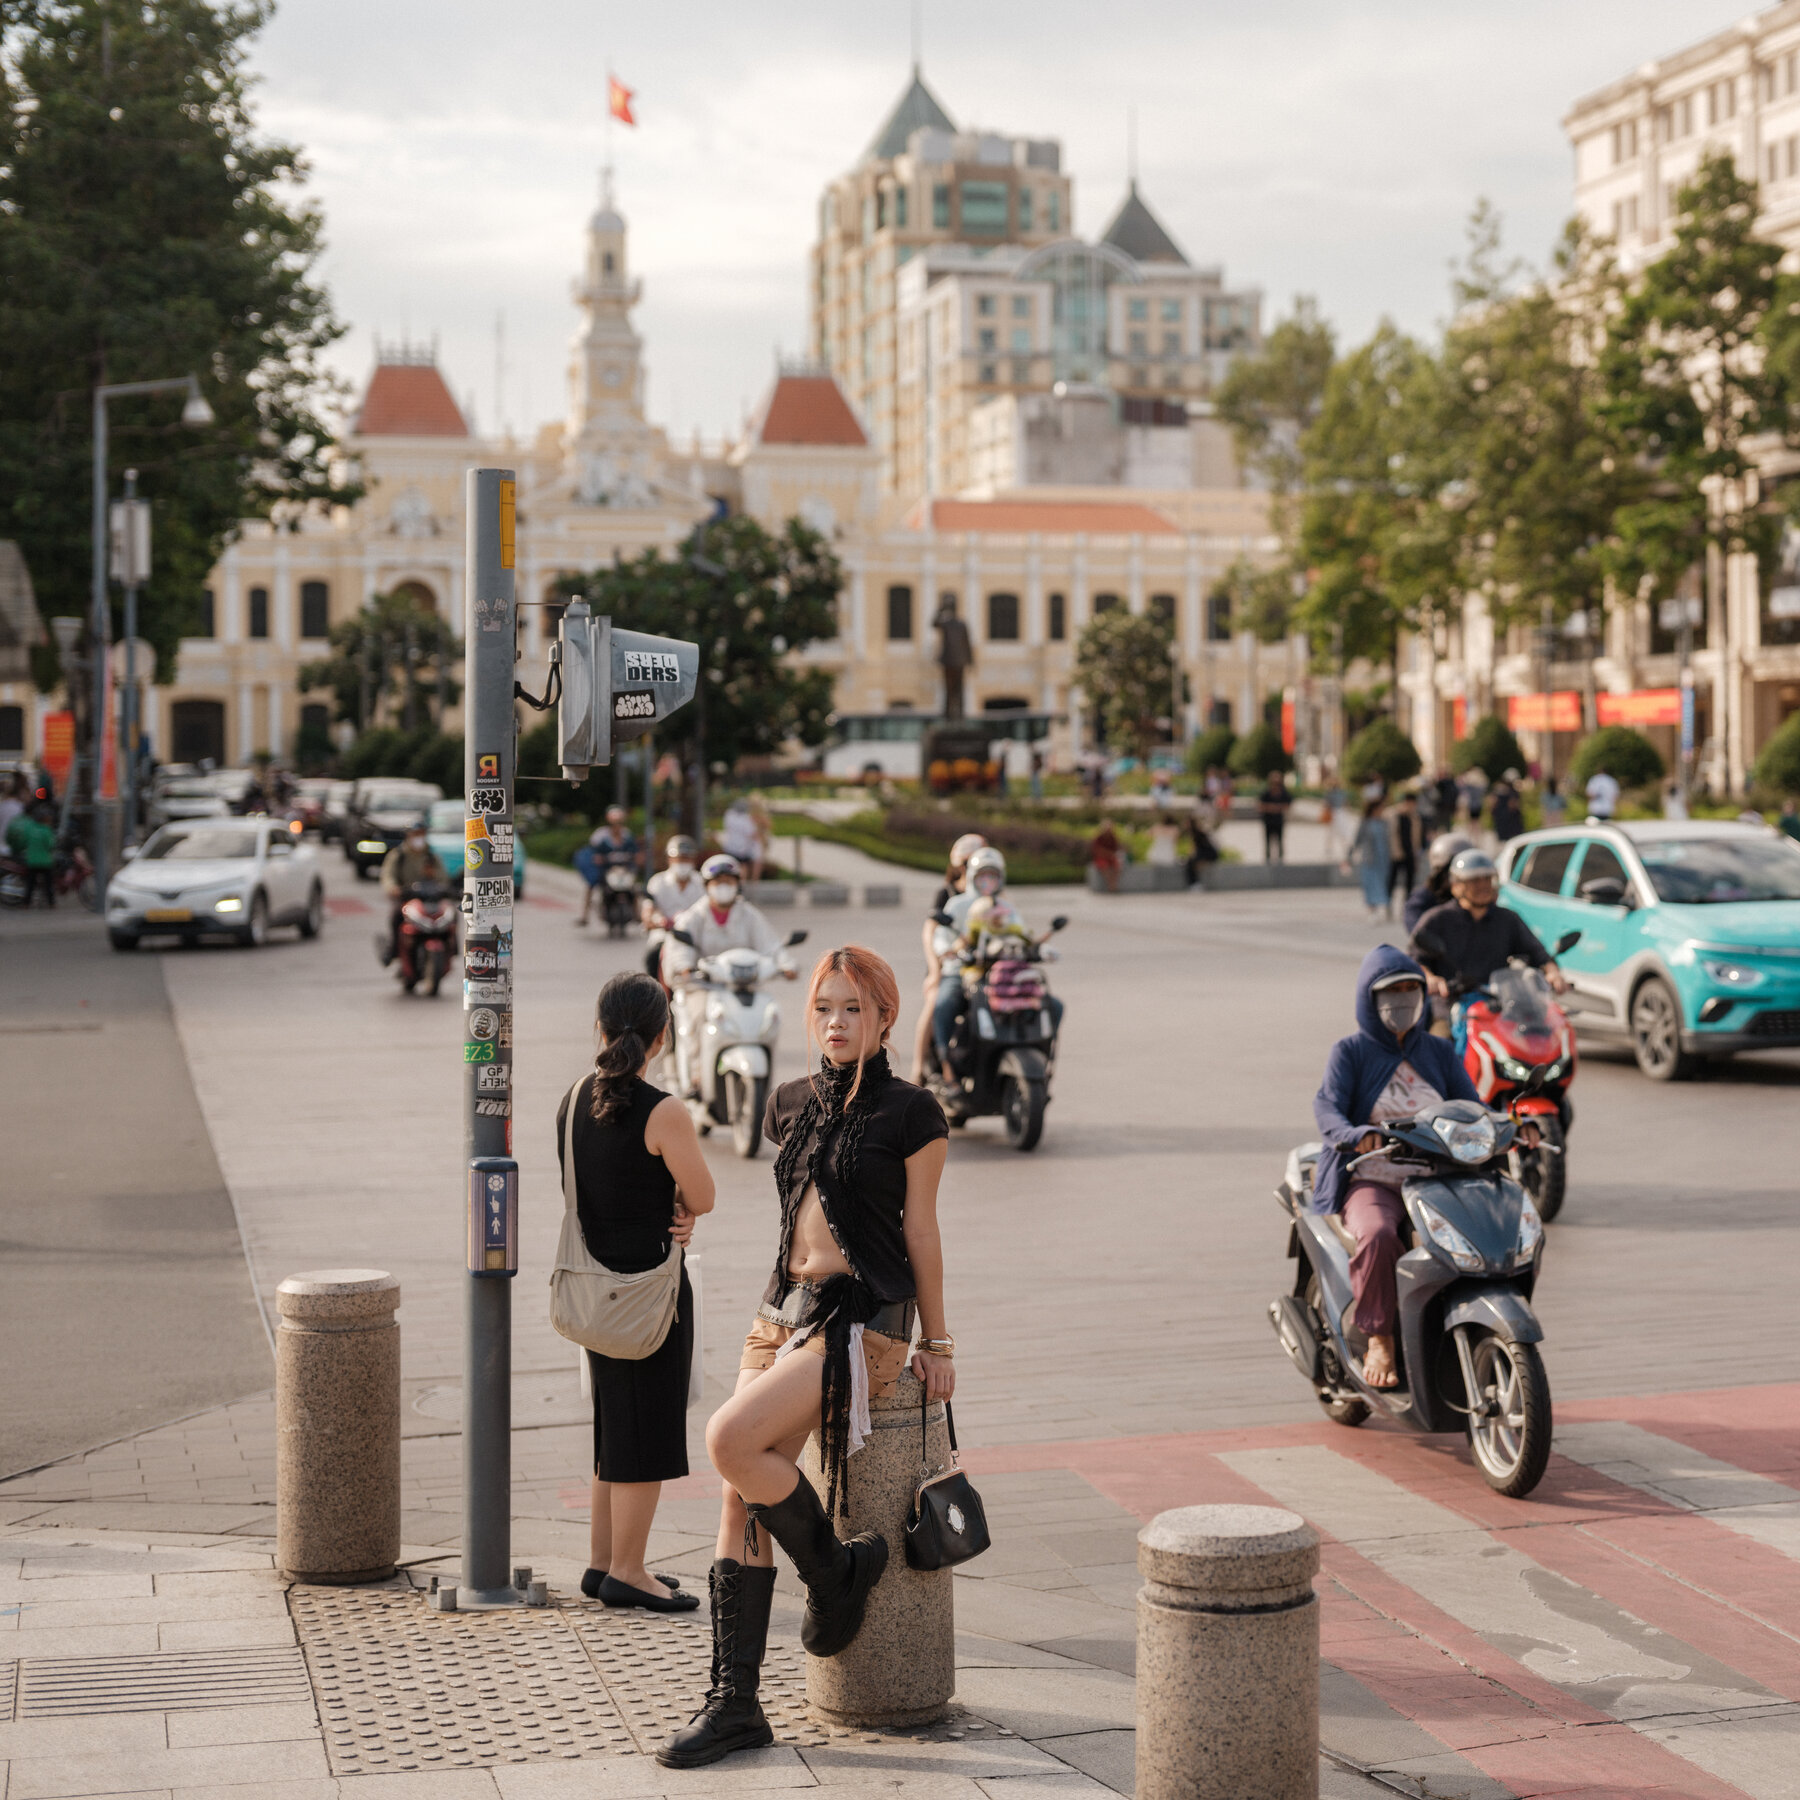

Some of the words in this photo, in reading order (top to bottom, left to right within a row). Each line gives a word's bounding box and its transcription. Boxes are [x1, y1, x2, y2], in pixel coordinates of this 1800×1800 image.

[627, 667, 678, 681] DERS
[477, 880, 510, 896] ZIPGUN
[487, 1067, 503, 1076] GP
